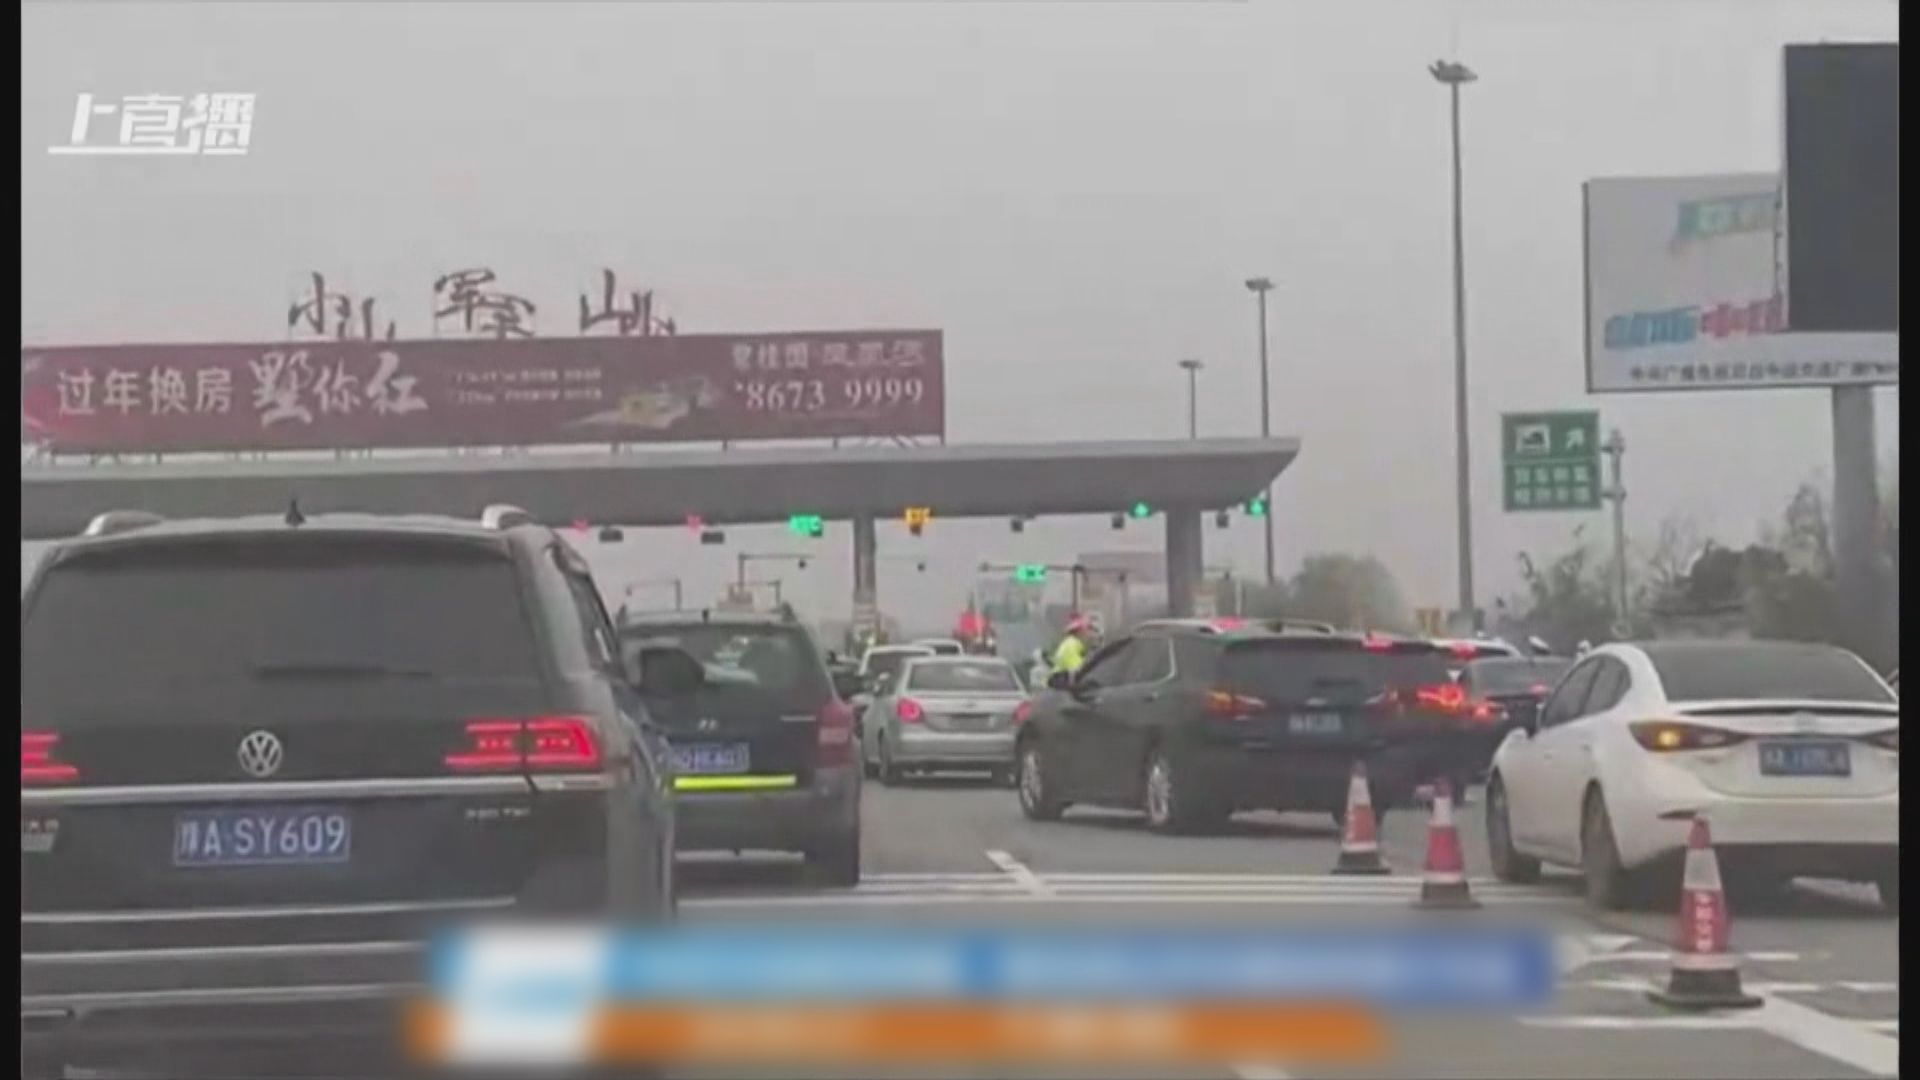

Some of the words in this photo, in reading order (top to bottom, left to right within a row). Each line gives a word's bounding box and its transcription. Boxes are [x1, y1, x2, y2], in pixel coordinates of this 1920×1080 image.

[57, 368, 232, 417] 过年换房
[845, 378, 923, 407] 9999
